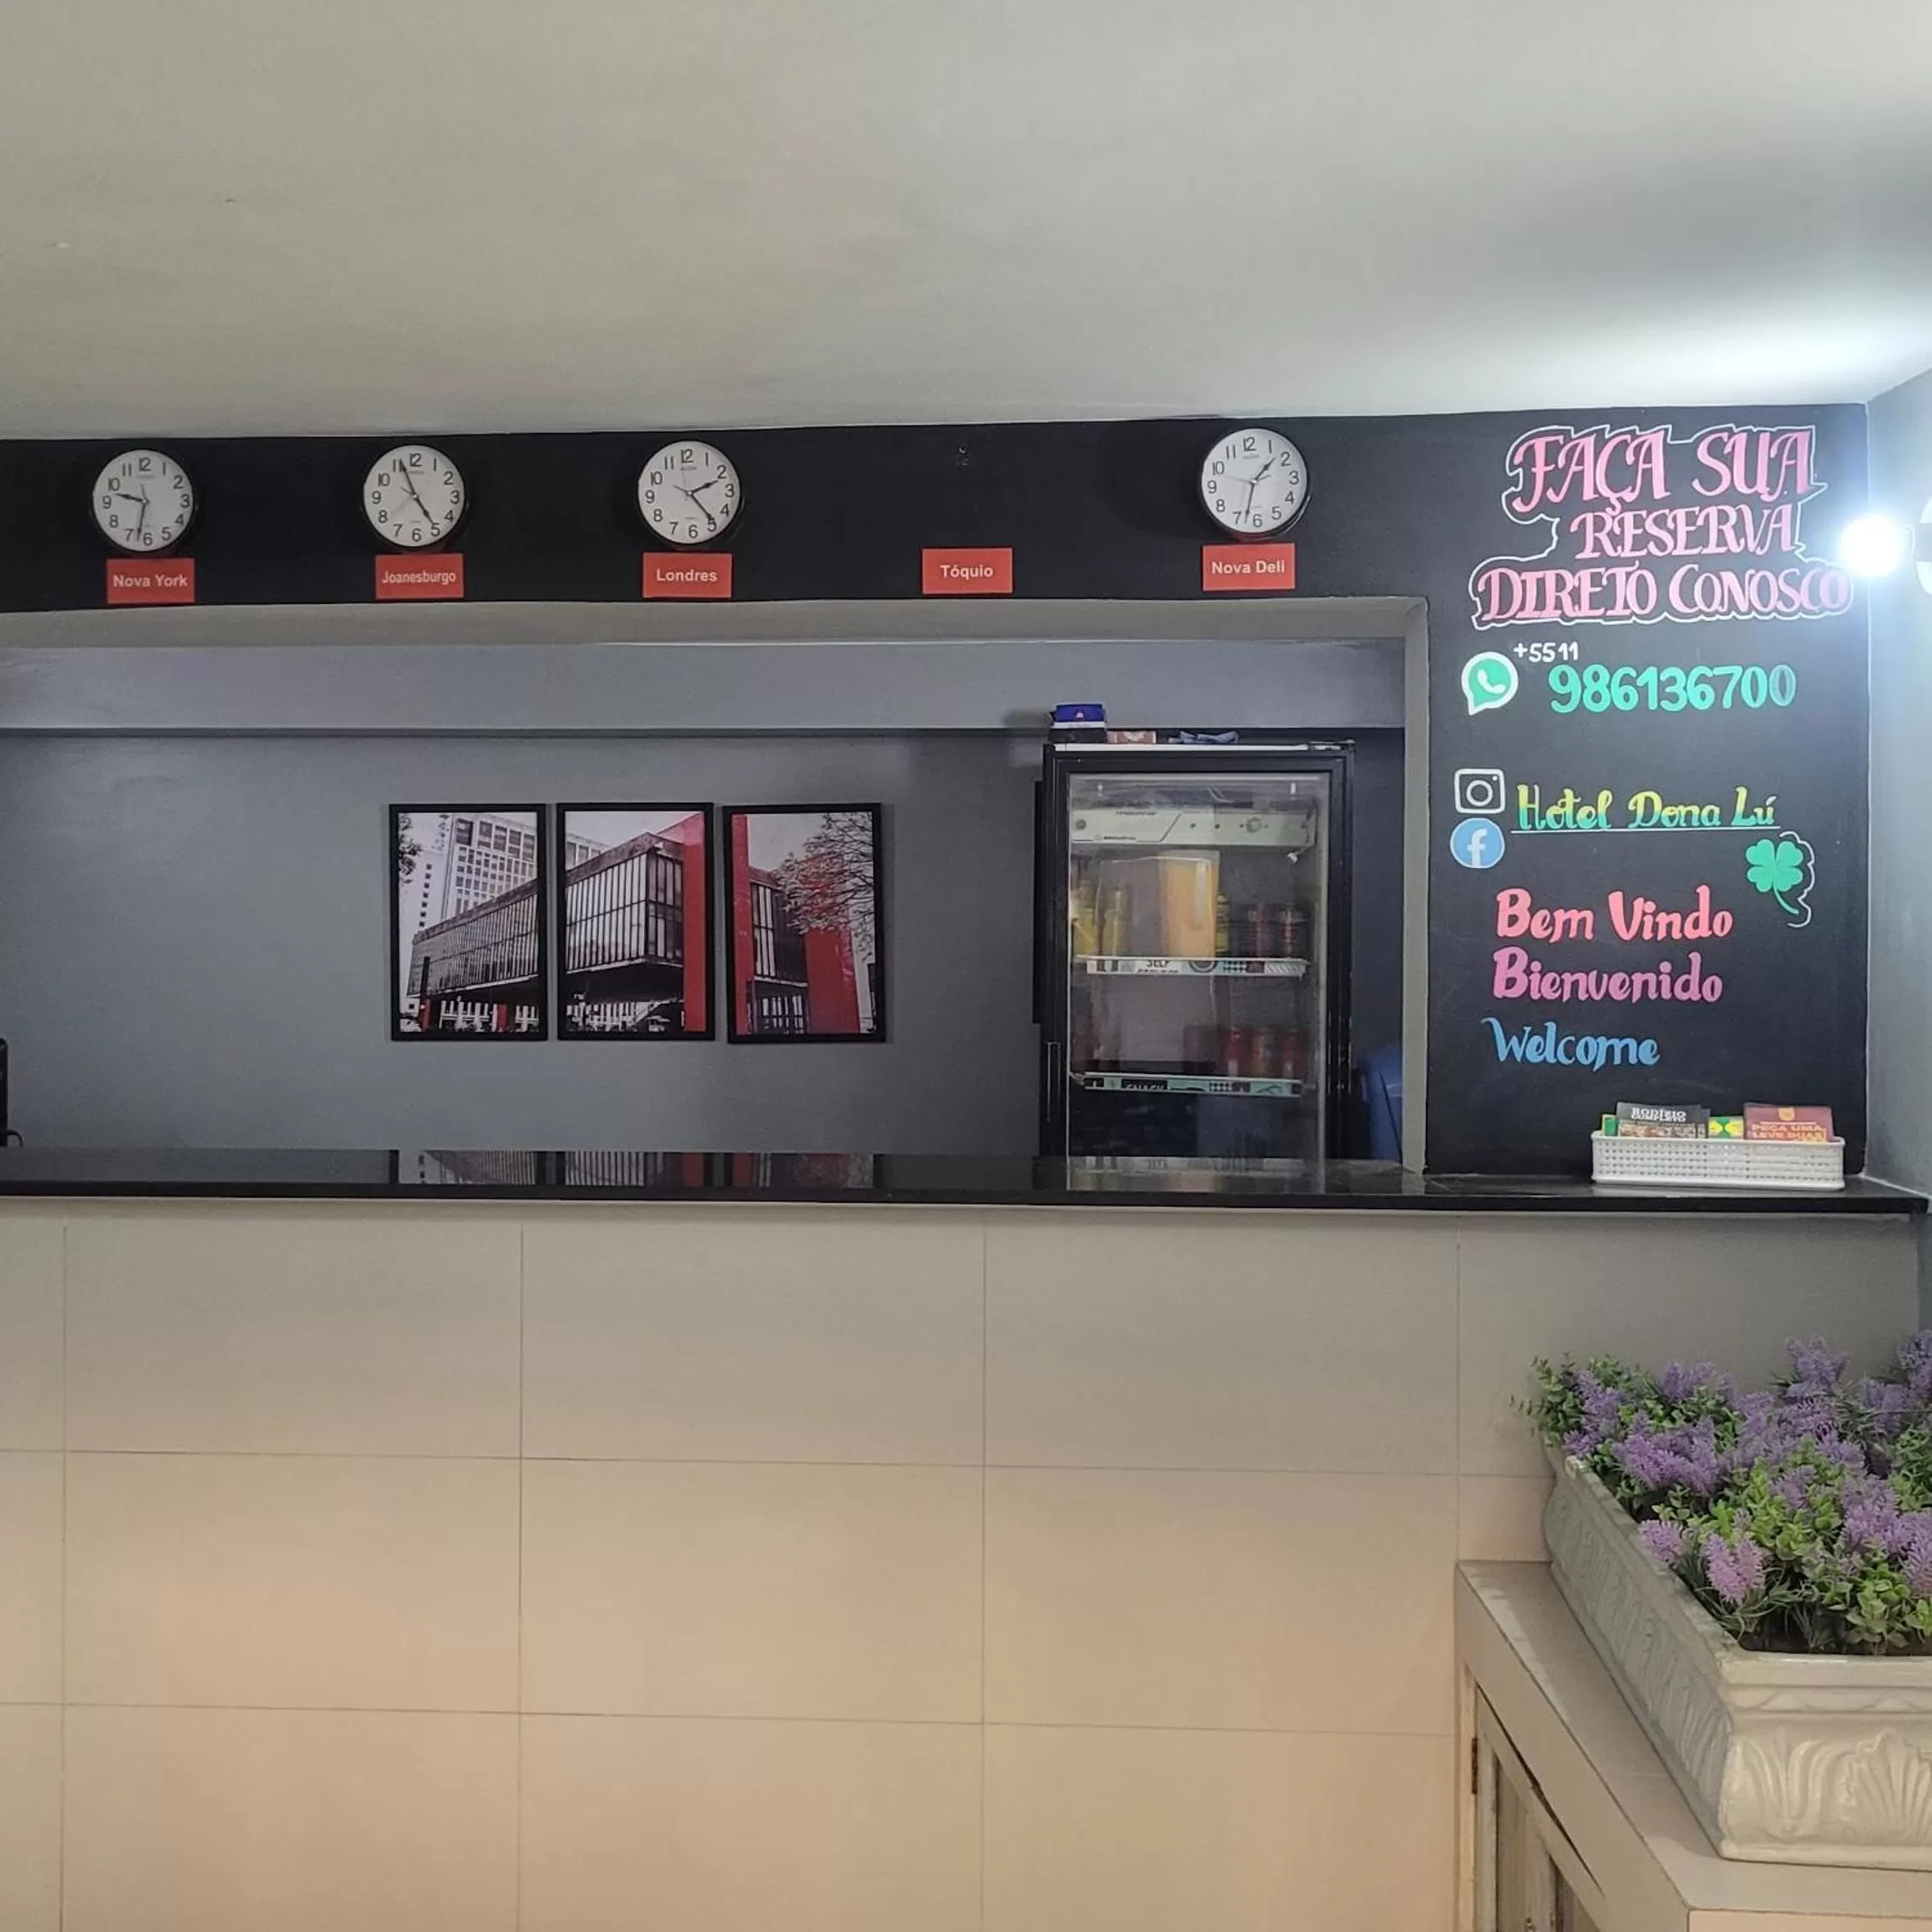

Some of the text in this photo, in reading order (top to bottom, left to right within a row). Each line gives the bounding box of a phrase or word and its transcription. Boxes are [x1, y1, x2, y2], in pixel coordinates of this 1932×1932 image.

[1243, 436, 1256, 451] 12
[1268, 440, 1272, 453] 1
[409, 452, 423, 467] 12
[681, 449, 693, 463] 12
[705, 452, 709, 466] 1
[1226, 445, 1236, 460] 11
[1280, 451, 1291, 467] 2
[139, 457, 152, 472] 12
[163, 462, 166, 475] 1
[393, 458, 403, 473] 11
[434, 457, 437, 471] 1
[664, 456, 674, 469] 11
[1212, 461, 1225, 475] 10
[122, 463, 132, 477] 11
[716, 464, 727, 479] 2
[1512, 428, 1813, 514] FAÇA SUA
[107, 477, 121, 492] 10
[173, 474, 184, 489] 2
[378, 473, 390, 486] 10
[443, 471, 454, 486] 2
[650, 471, 663, 486] 10
[1288, 470, 1300, 486] 3
[725, 483, 735, 497] 3
[1207, 480, 1216, 494] 9
[102, 496, 112, 509] 9
[180, 493, 190, 509] 3
[371, 490, 382, 504] 9
[450, 490, 460, 504] 3
[645, 490, 654, 503] 9
[1285, 491, 1296, 504] 4
[721, 503, 729, 517] 4
[1216, 498, 1226, 512] 8
[175, 514, 185, 526] 4
[378, 509, 388, 523] 8
[444, 509, 455, 522] 4
[653, 509, 663, 522] 8
[1233, 511, 1242, 525] 7
[1271, 506, 1282, 520] 5
[109, 515, 118, 527] 8
[707, 519, 716, 532] 5
[1252, 514, 1262, 527] 6
[124, 528, 134, 541] 7
[162, 526, 171, 541] 5
[393, 524, 403, 538] 7
[411, 528, 422, 542] 6
[430, 522, 440, 537] 5
[670, 521, 679, 535] 7
[688, 525, 699, 538] 6
[1569, 503, 1797, 561] RESERVA
[143, 532, 153, 546] 6
[939, 564, 994, 581] Tóquio
[1211, 560, 1285, 575] Nova Deli
[113, 574, 188, 587] Nova York
[382, 570, 457, 585] Joanesburgo
[656, 568, 718, 582] Londres
[1478, 560, 1852, 622] DIRETO CONOSCO
[1547, 664, 1797, 714] 986136700
[1516, 784, 1613, 831] Hotel
[1627, 790, 1721, 830] Dona
[1495, 884, 1734, 944] Bem Vindo
[1492, 946, 1723, 1003] Bienvenido
[1481, 1016, 1660, 1072] Welcome
